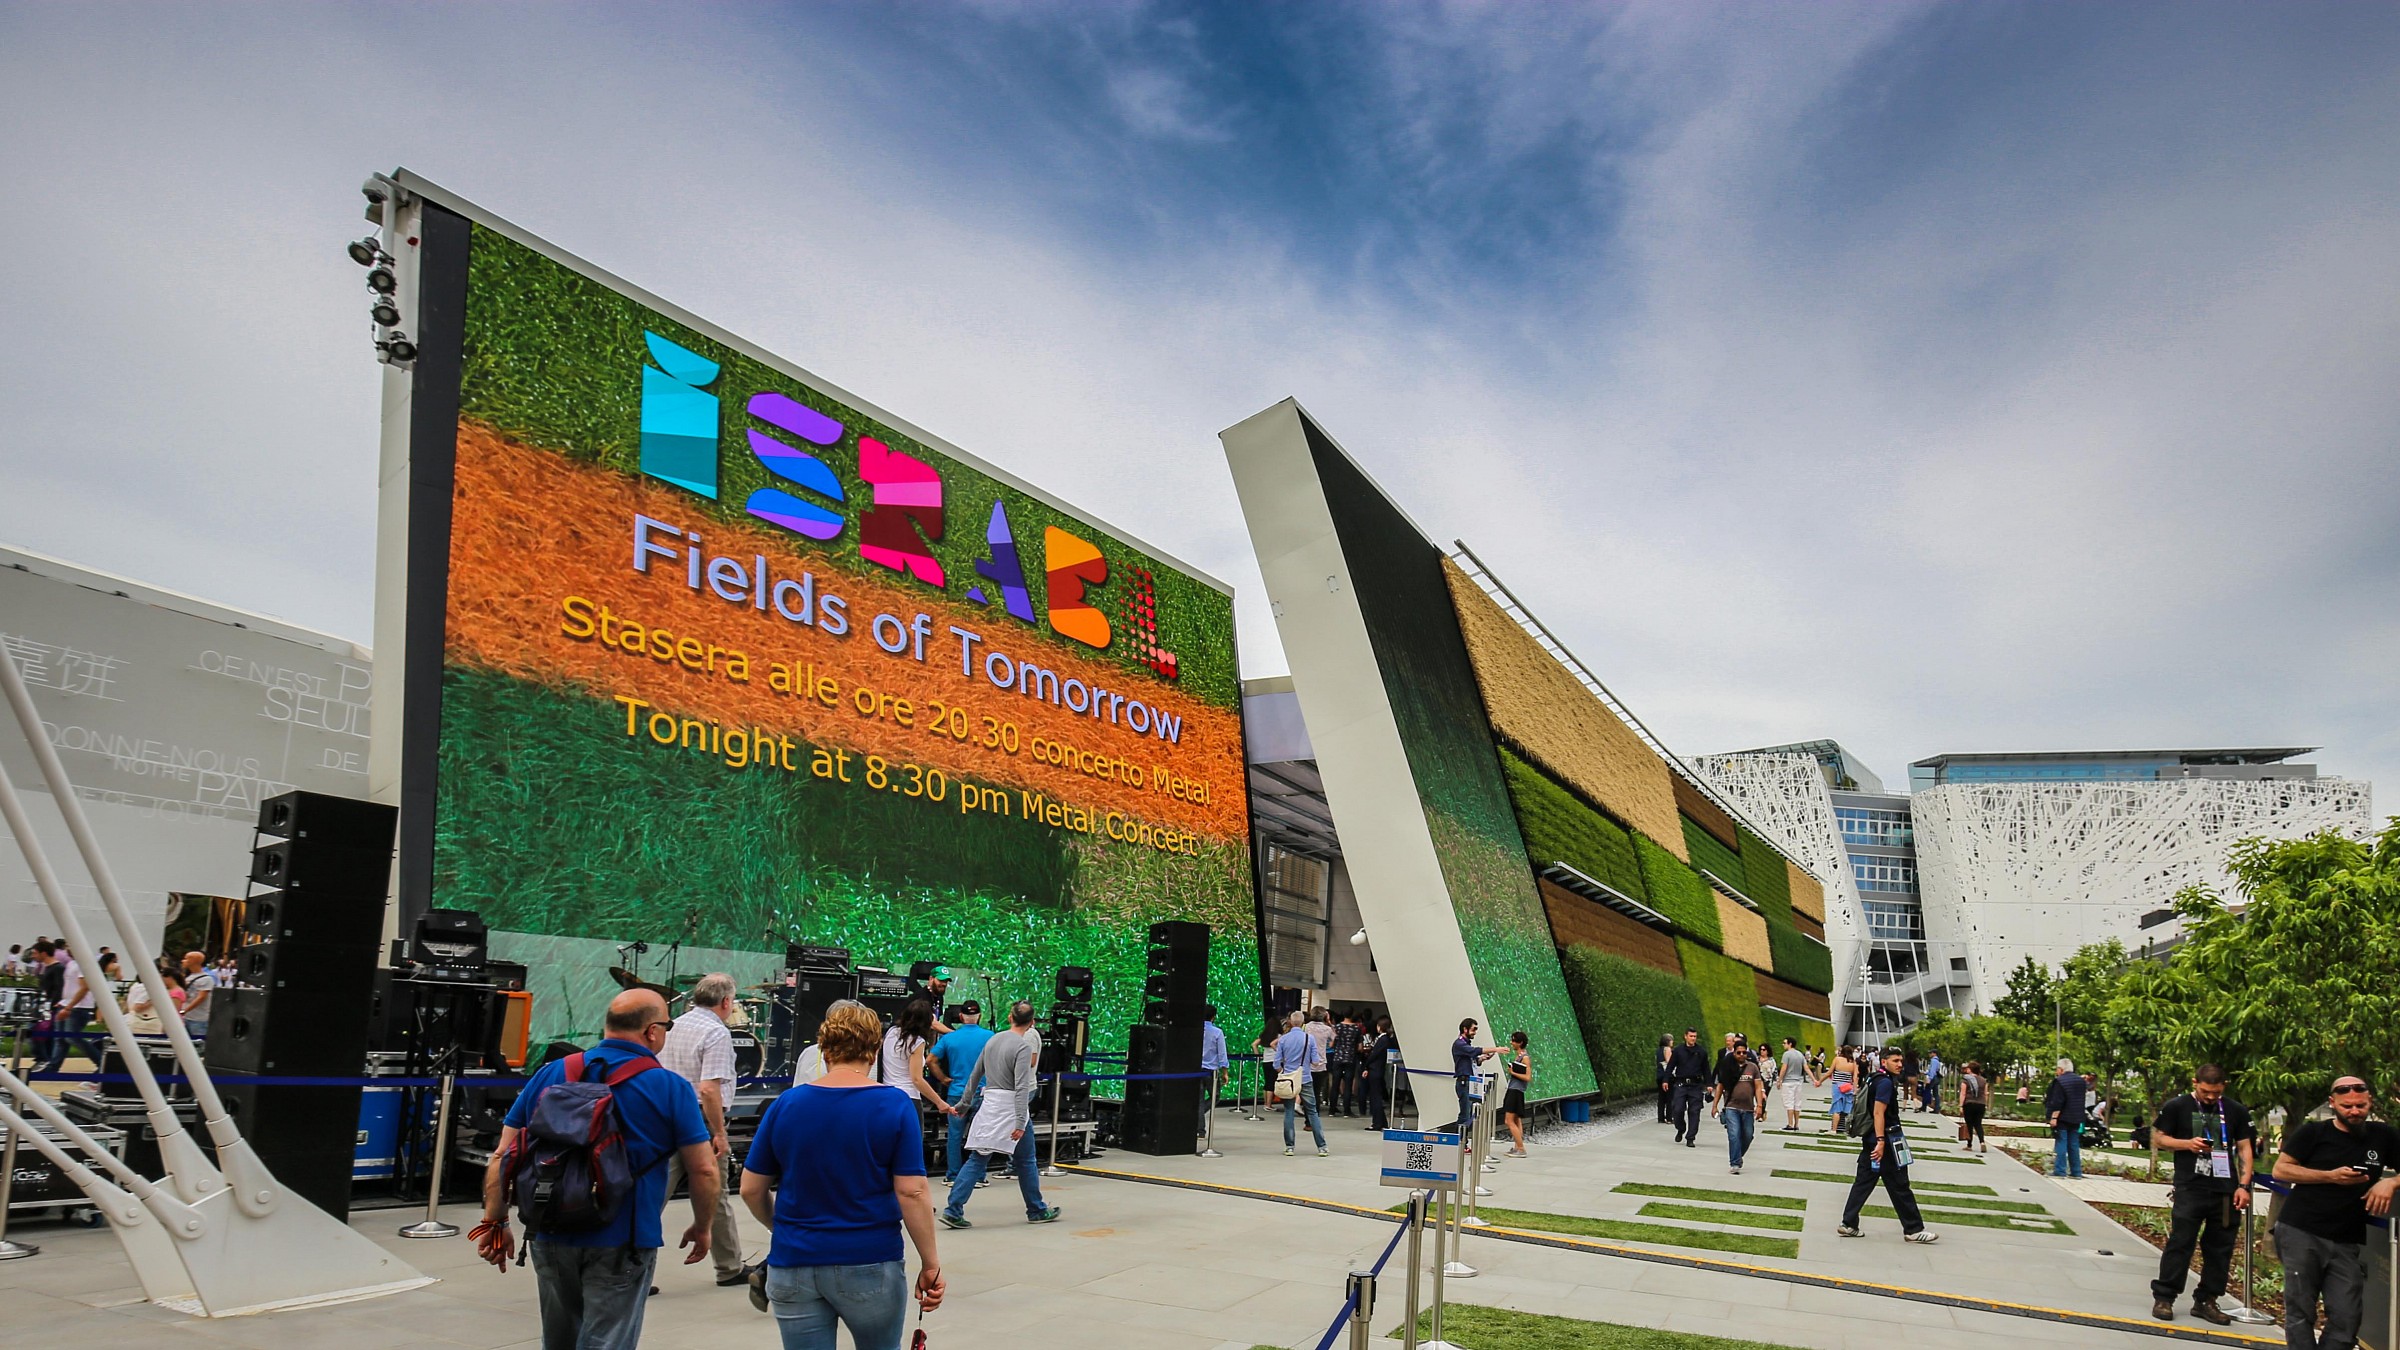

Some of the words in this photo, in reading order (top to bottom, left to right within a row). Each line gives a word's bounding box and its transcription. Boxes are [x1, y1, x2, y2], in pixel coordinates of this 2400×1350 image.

[200, 649, 244, 677] CE
[336, 661, 374, 710] P
[632, 512, 849, 636] Fields
[871, 612, 932, 662] of
[949, 624, 1183, 744] Tomorrow
[560, 594, 750, 682] Stasera
[767, 660, 840, 706] alle
[853, 686, 914, 726] ore
[927, 699, 1020, 754] 20.30
[1030, 736, 1145, 789] concerto
[1152, 764, 1212, 806] Metal
[322, 748, 361, 772] DE
[614, 693, 797, 772] Tonight
[810, 747, 852, 783] at
[865, 754, 947, 803] 8.30
[959, 780, 1010, 816] pm
[1021, 789, 1096, 835] Metal
[1104, 811, 1198, 857] Concert
[1422, 1134, 1439, 1143] WIN
